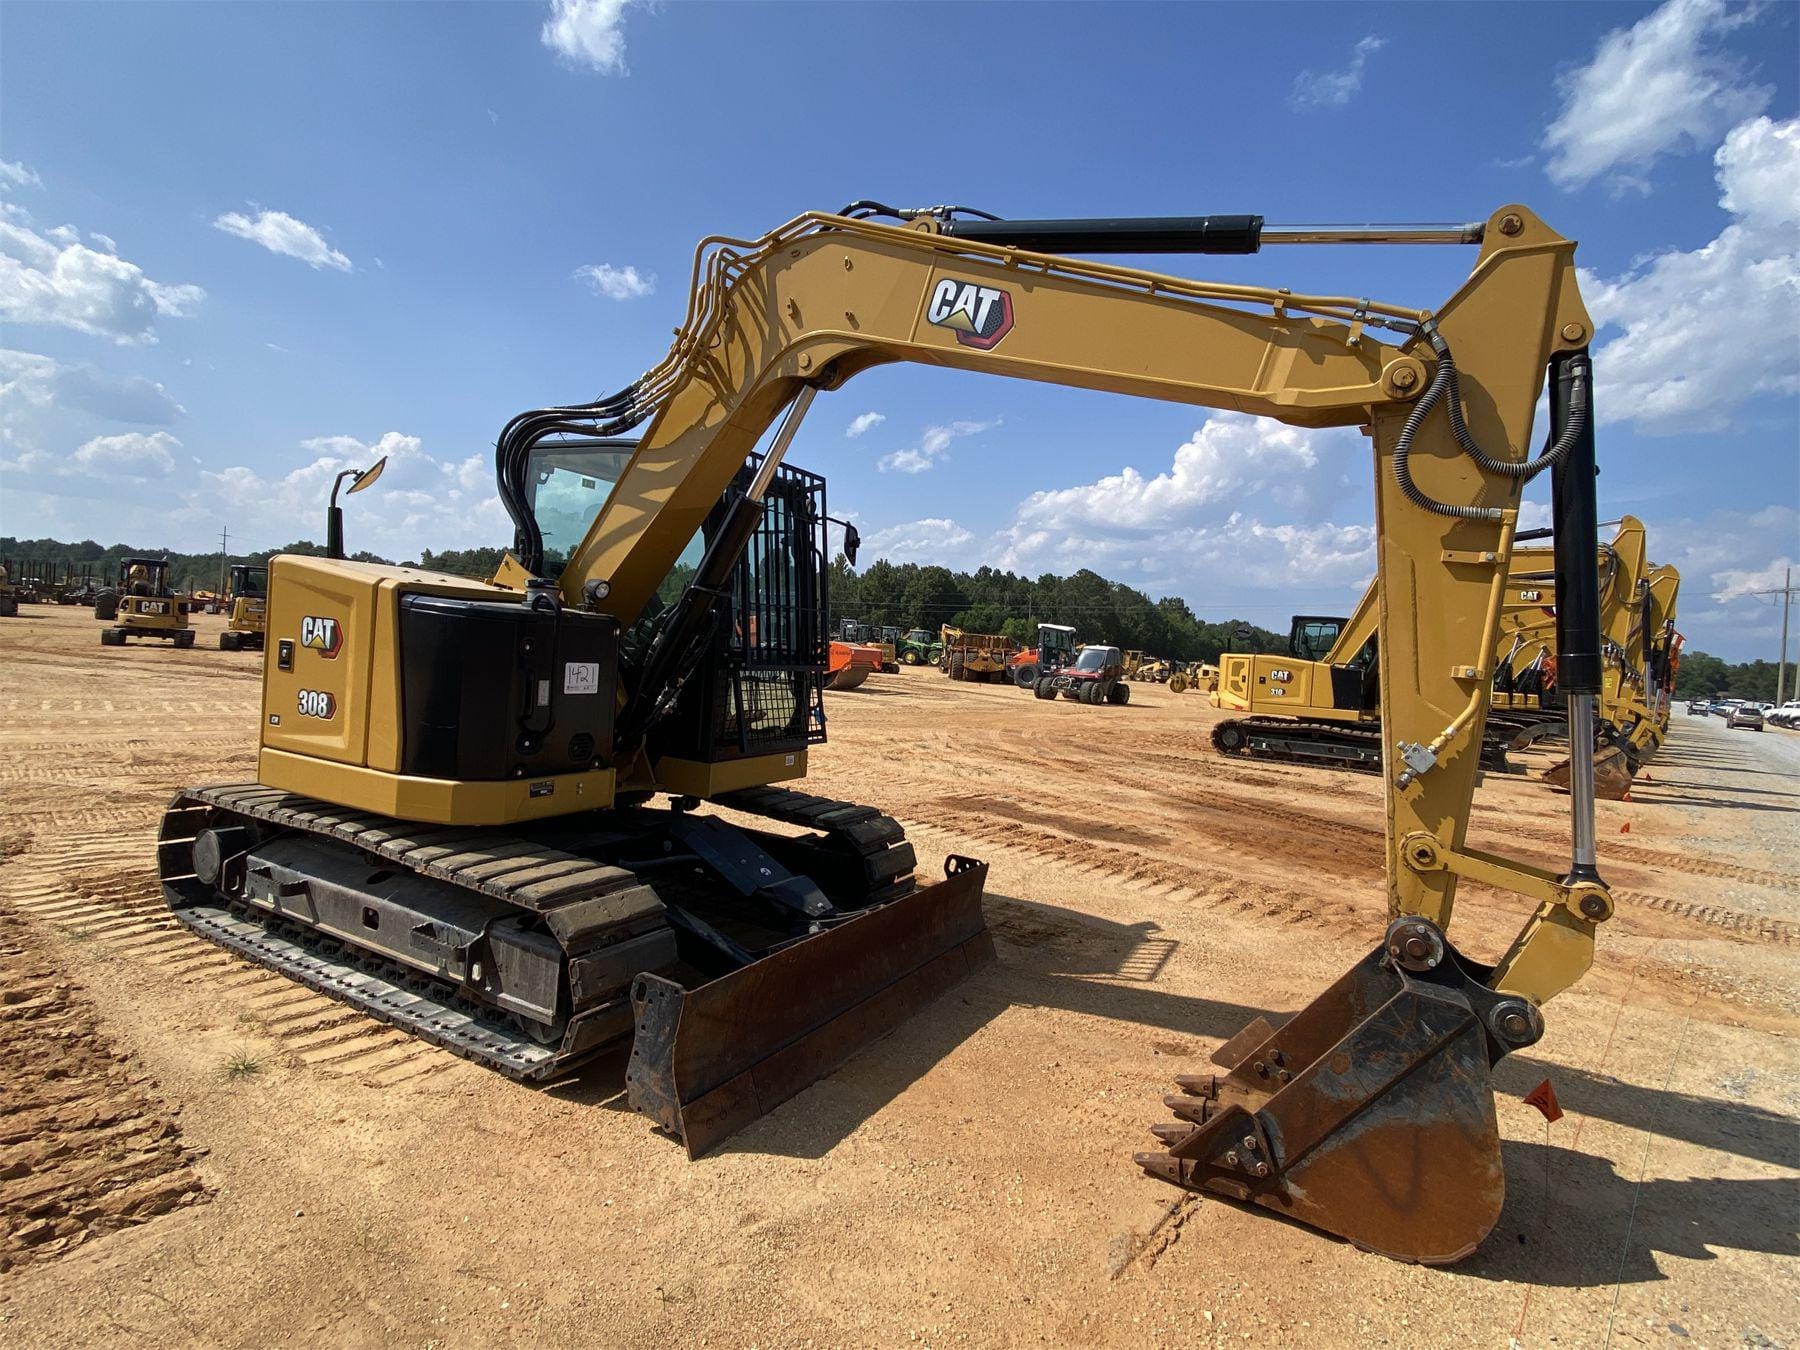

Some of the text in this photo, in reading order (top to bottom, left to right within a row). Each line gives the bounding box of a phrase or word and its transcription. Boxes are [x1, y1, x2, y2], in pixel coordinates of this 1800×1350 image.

[928, 279, 1001, 334] CAT
[1520, 591, 1539, 600] CAT
[141, 601, 165, 614] CAT
[302, 616, 334, 649] CAT
[568, 664, 595, 684] 1421
[1271, 670, 1289, 680] CAT
[1270, 688, 1283, 696] 310
[298, 690, 328, 717] 308
